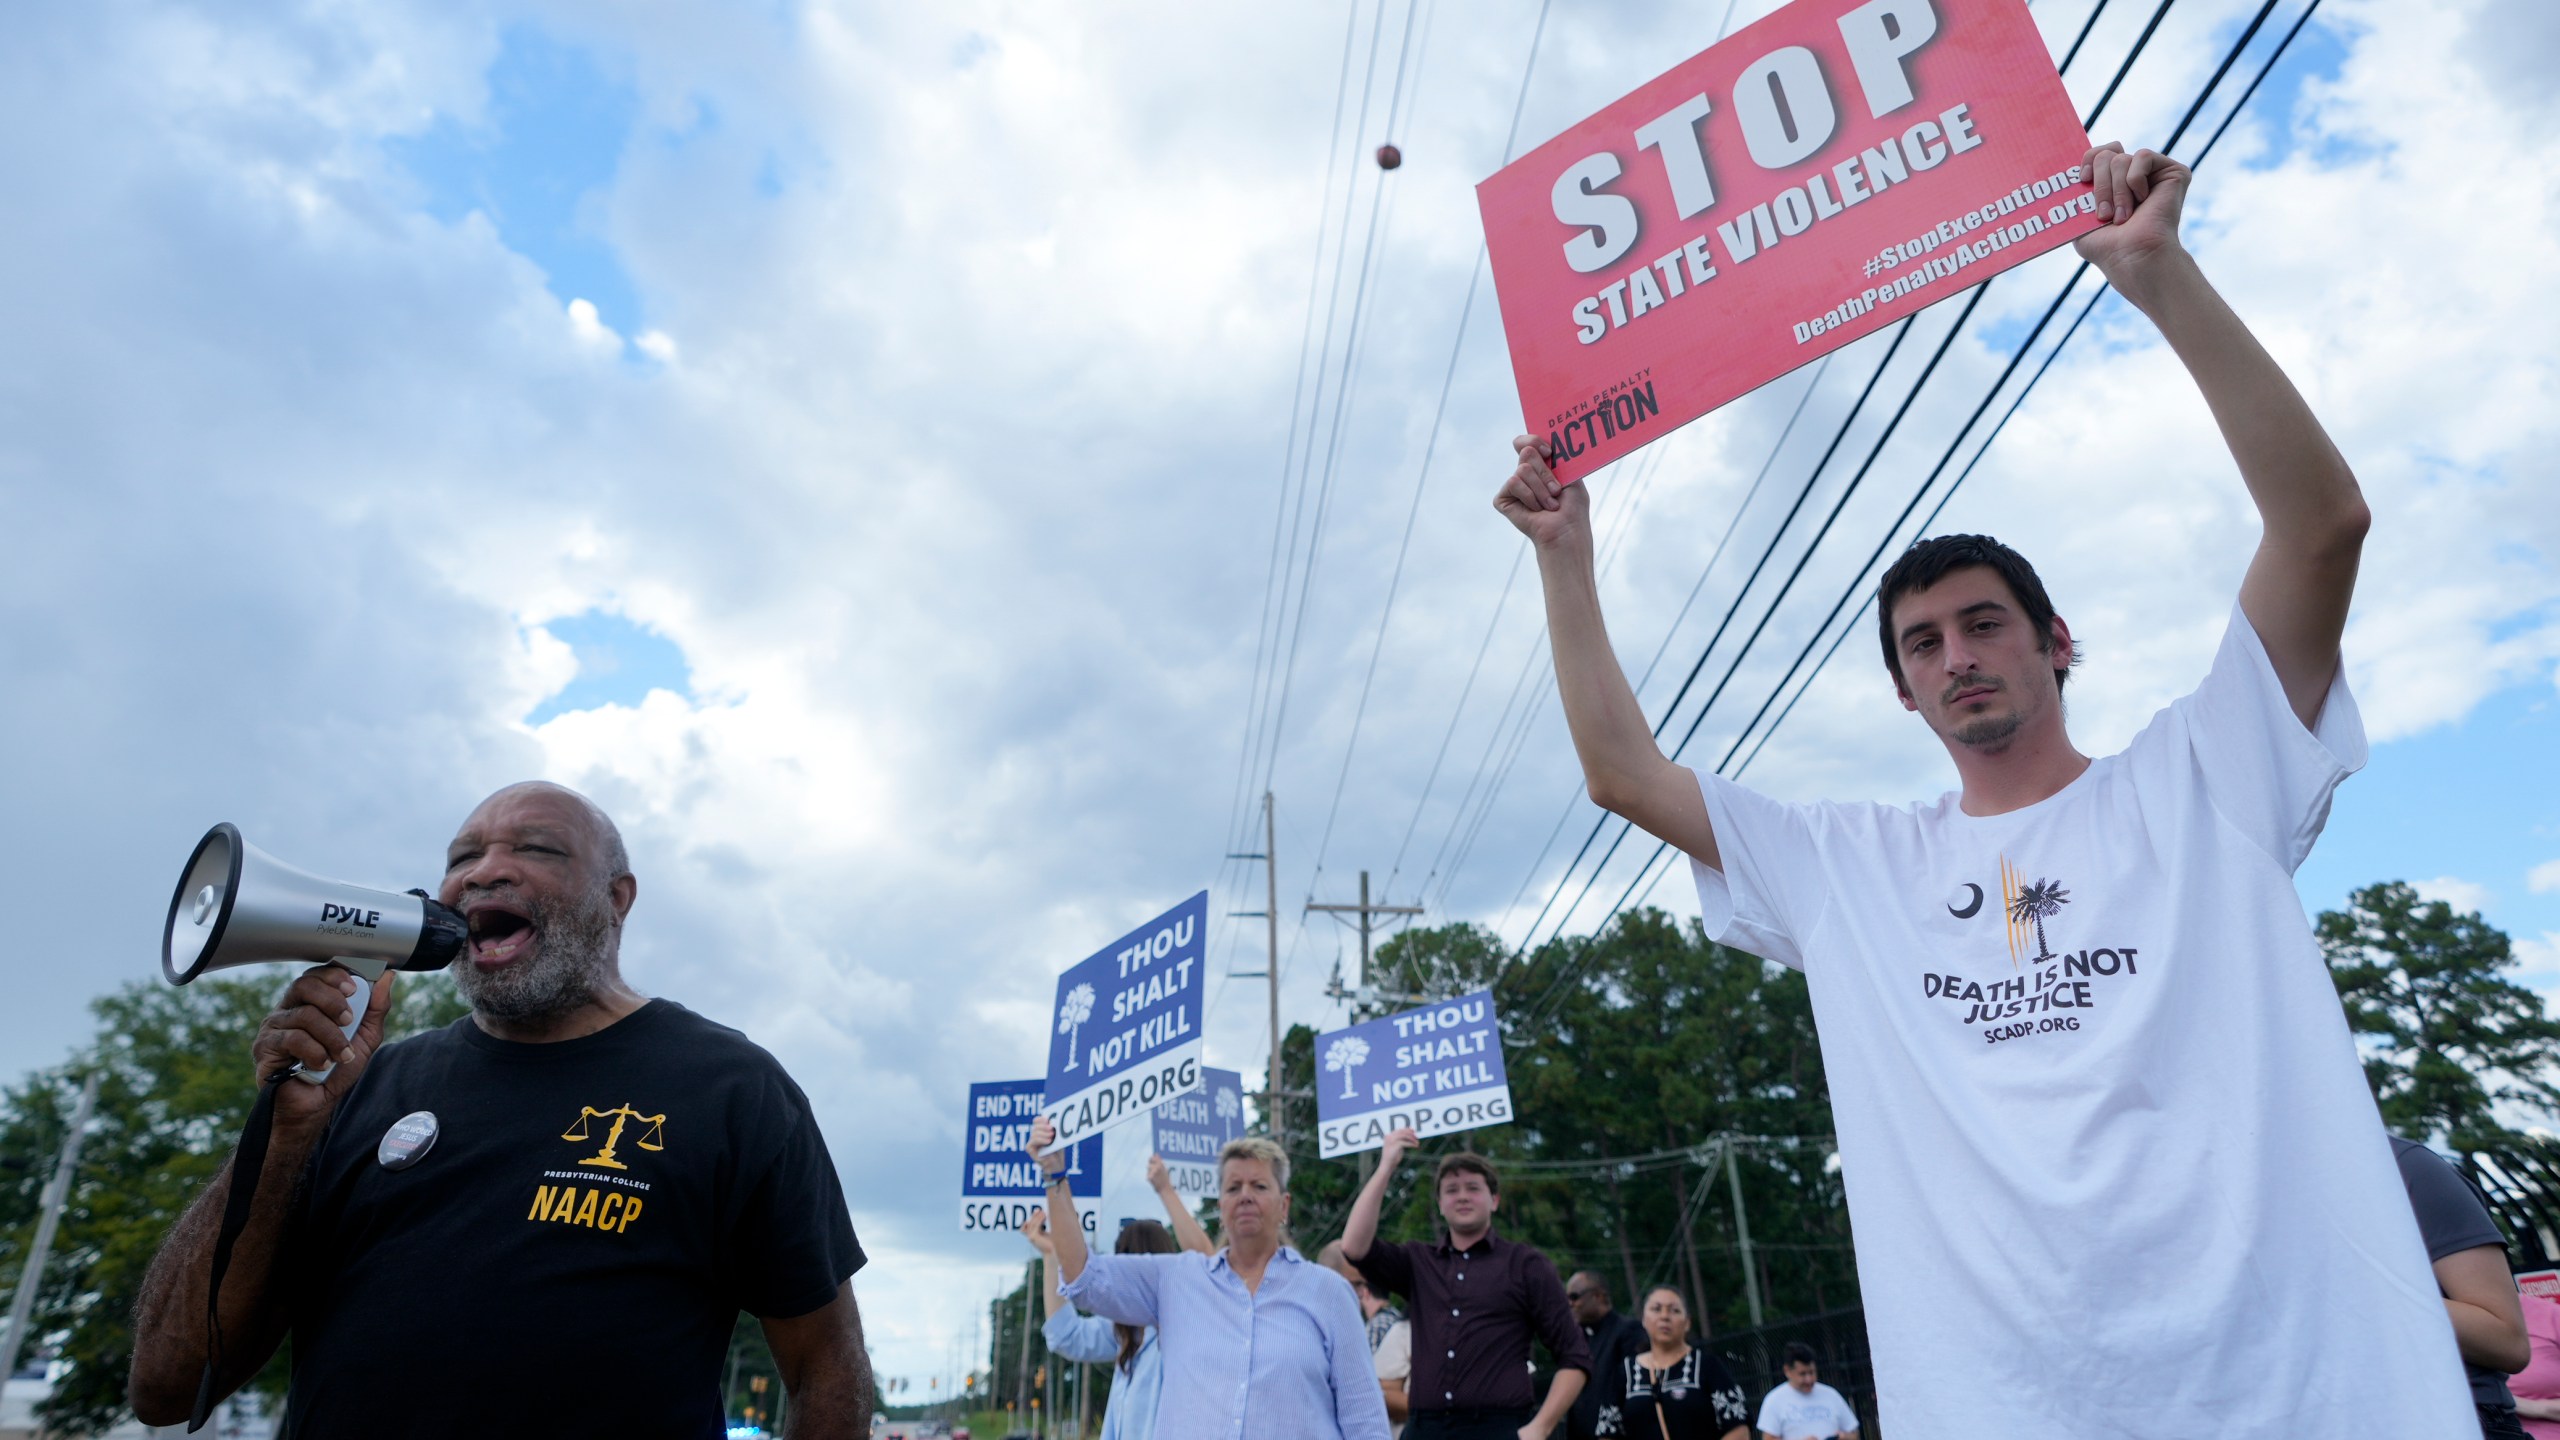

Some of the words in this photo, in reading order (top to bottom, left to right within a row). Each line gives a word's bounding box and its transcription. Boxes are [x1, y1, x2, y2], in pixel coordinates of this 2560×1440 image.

[1551, 0, 1937, 272] STOP
[1572, 234, 1717, 345] STATE
[1717, 102, 1982, 264] VIOLENCE
[1862, 165, 2082, 279] #StopExecutions
[1792, 191, 2097, 345] DeathPenaltyAction.org
[1548, 401, 1588, 428] DEATH
[1593, 367, 1651, 404] PENALTY
[1551, 380, 1659, 470] ACTION
[317, 924, 374, 939] PyleUSA.com
[321, 903, 380, 928] PYLE
[1117, 914, 1194, 979] THOU
[1112, 956, 1194, 1023] SHALT
[1924, 973, 2024, 1002] DEATH
[2035, 964, 2058, 993] IS
[2064, 948, 2138, 977] NOT
[1393, 1000, 1485, 1038] THOU
[1963, 981, 2094, 1024] JUSTICE
[1088, 1028, 1136, 1077] NOT
[1140, 1004, 1190, 1053] KILL
[1395, 1030, 1489, 1068] SHALT
[1984, 1017, 2080, 1044] SCADP.ORG
[1372, 1073, 1429, 1104] NOT
[1435, 1061, 1494, 1091] KILL
[976, 1095, 1011, 1118] END
[1013, 1093, 1046, 1117] THE
[1158, 1099, 1209, 1125] DEATH
[1323, 1098, 1506, 1151] SCADP.ORG
[974, 1124, 1034, 1152] DEAT
[1159, 1130, 1219, 1156] PENALTY
[544, 1171, 610, 1182] PRESBYTERIAN
[612, 1177, 651, 1191] COLLEGE
[972, 1162, 1043, 1188] PENALT
[528, 1185, 643, 1233] NAACP
